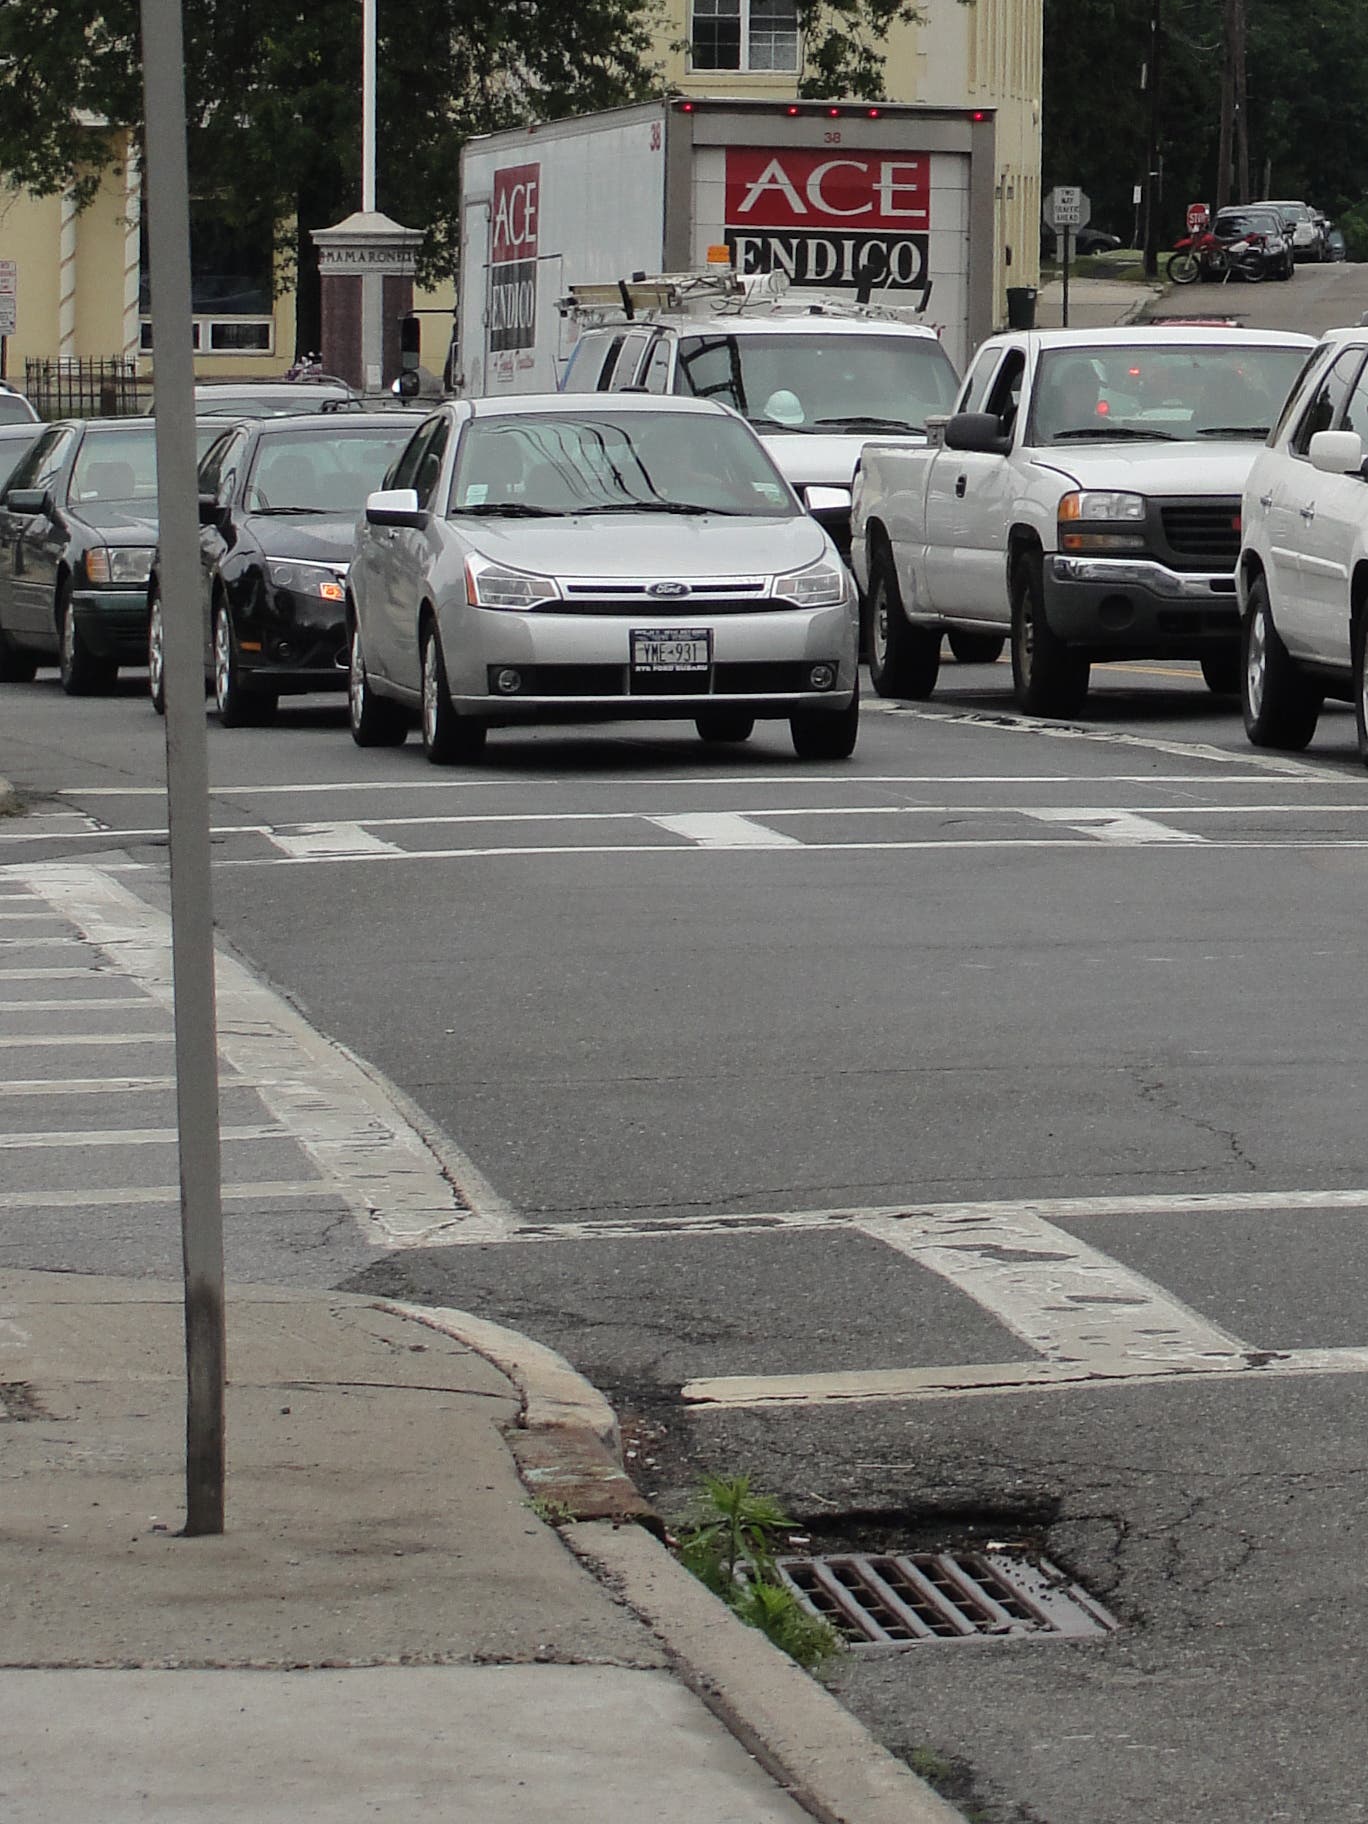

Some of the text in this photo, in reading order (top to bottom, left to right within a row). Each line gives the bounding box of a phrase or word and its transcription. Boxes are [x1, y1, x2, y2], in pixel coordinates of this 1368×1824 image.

[824, 131, 842, 144] 38
[736, 158, 927, 218] ACE
[493, 181, 538, 249] ACE
[733, 236, 922, 284] ENDICO
[490, 279, 535, 332] ENDICO
[656, 583, 682, 594] Ford
